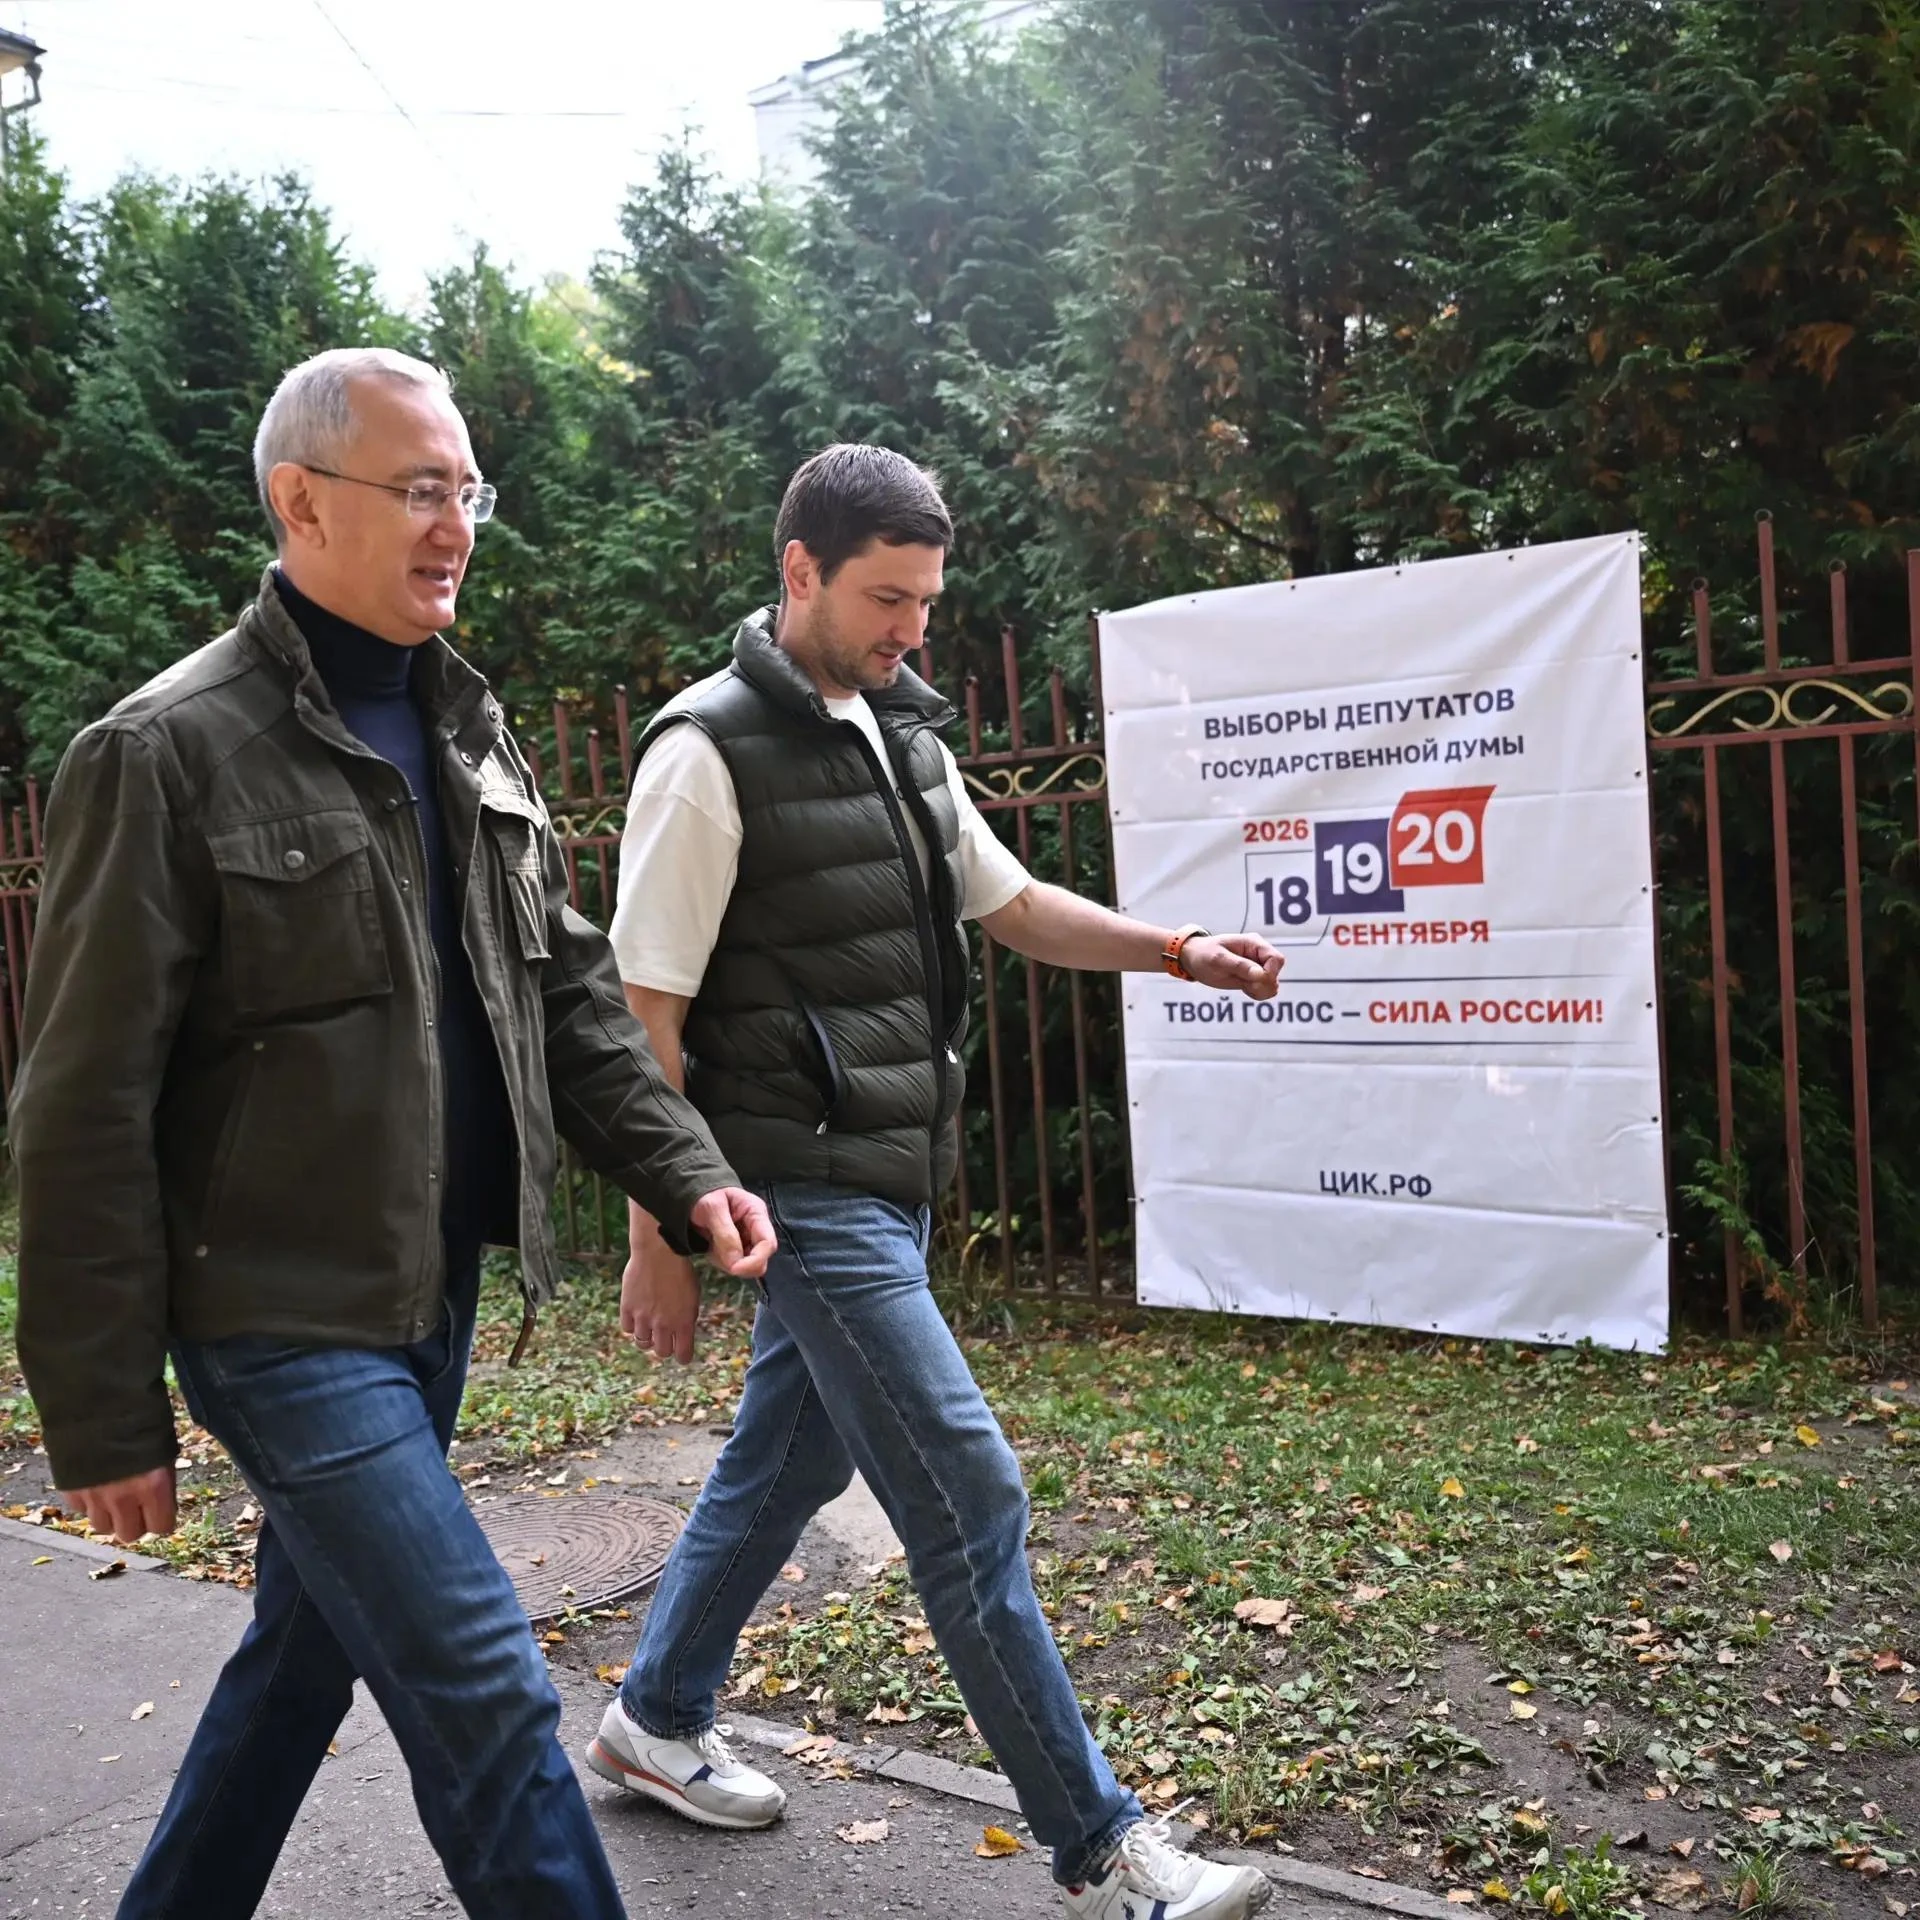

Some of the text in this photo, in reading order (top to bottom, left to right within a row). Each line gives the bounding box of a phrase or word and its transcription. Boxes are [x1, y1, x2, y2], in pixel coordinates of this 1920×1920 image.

[1204, 688, 1515, 740] ВЫБОРЫ ДЕПУТАТОВ
[1201, 735, 1525, 780] ГОСУДАРСТВЕННОЙ ДУМЫ
[1243, 818, 1309, 843] 2026
[1254, 809, 1475, 926] 18 19 20
[1333, 920, 1490, 946] СЕНТЯБРЯ
[1163, 995, 1235, 1023] ТВОЙ
[1242, 1001, 1334, 1023] ГОЛОС
[1368, 1000, 1451, 1024] СИЛА
[1460, 999, 1603, 1024] РОССИИ!
[1319, 1170, 1432, 1198] ЦИК.РФ
